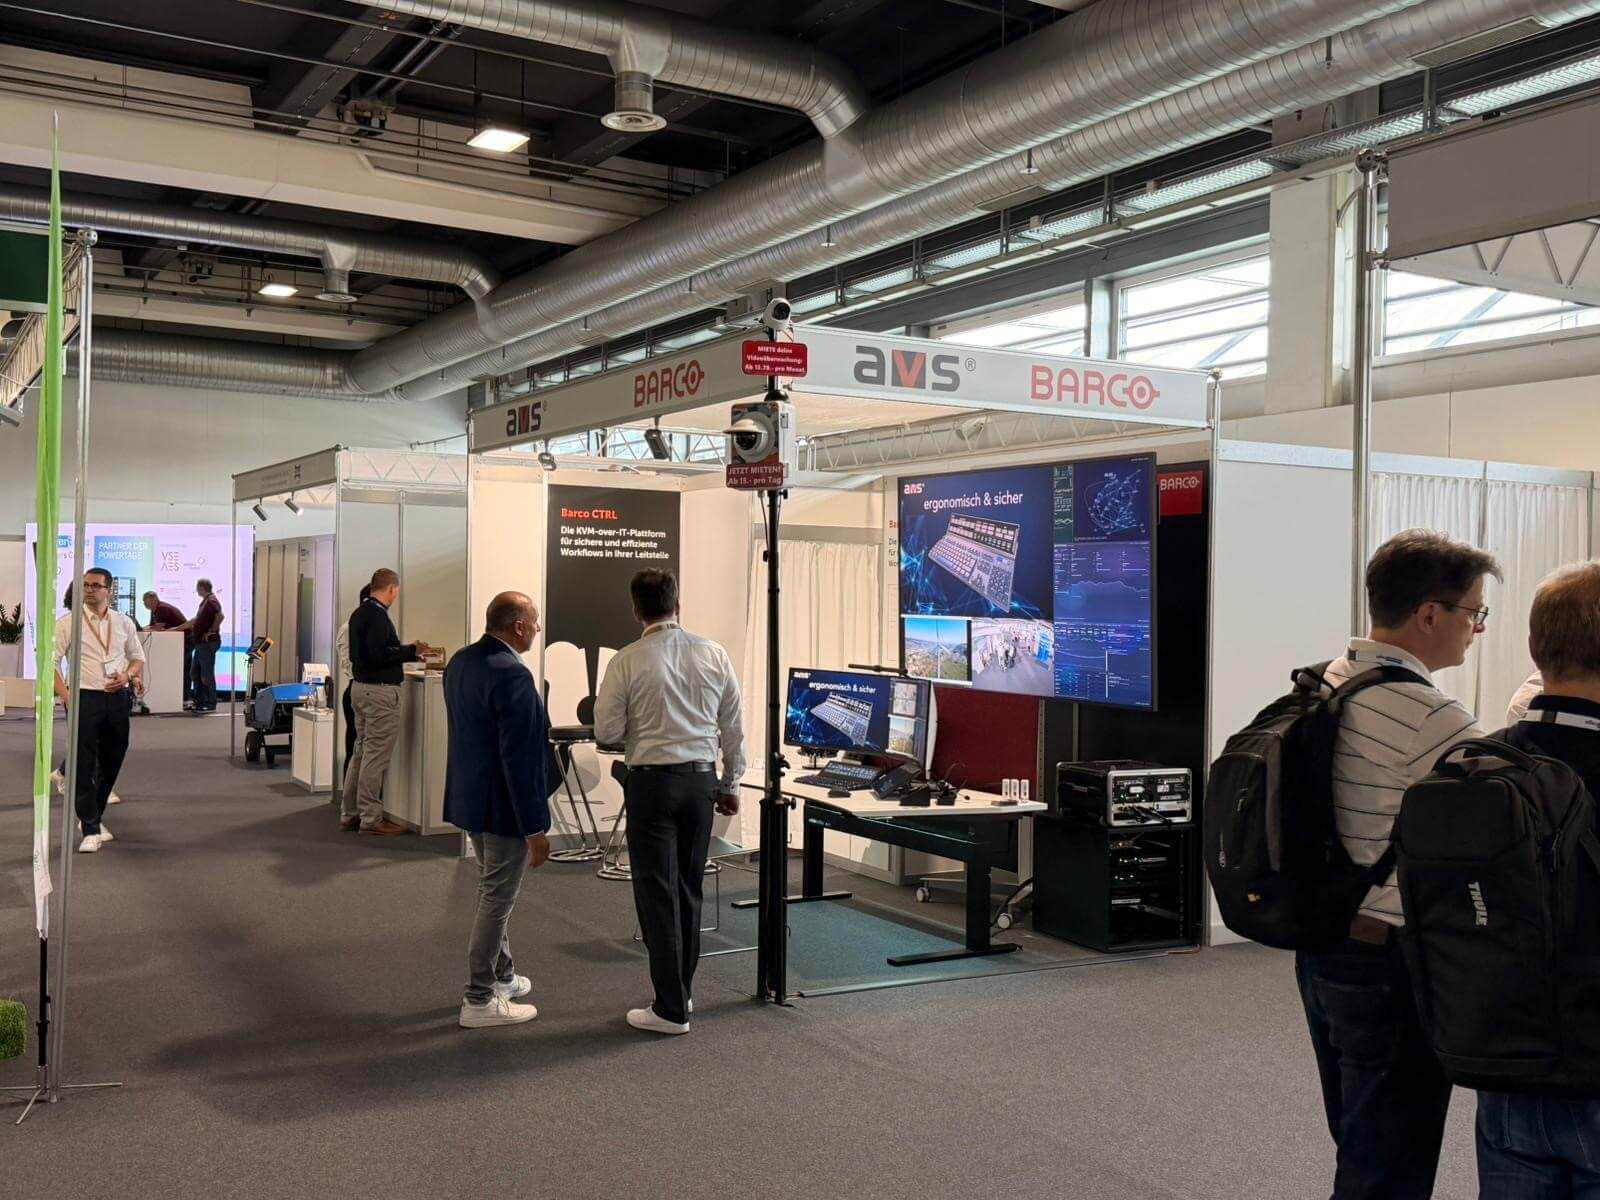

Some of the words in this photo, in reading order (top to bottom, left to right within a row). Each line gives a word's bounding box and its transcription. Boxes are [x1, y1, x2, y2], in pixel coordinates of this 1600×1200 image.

[634, 360, 704, 409] BARCO
[1031, 365, 1160, 410] BARCO
[728, 466, 748, 475] JETZT
[728, 477, 739, 486] Ab
[753, 479, 766, 487] pro
[768, 476, 782, 486] Tag
[1160, 476, 1200, 491] BARCO
[923, 494, 981, 513] ergonomisch
[983, 492, 991, 506] &
[993, 491, 1023, 505] sicher
[561, 508, 590, 518] Barco
[592, 509, 618, 520] CTRL
[560, 526, 575, 535] Die
[576, 527, 666, 538] KVM-over-IT-Plattform
[560, 537, 572, 546] für
[574, 538, 603, 547] sichere
[604, 539, 620, 548] und
[622, 540, 658, 549] effiziente
[161, 551, 180, 561] VSE
[560, 548, 604, 558] Workflows
[605, 549, 613, 558] in
[614, 549, 634, 558] Ihrer
[635, 550, 670, 559] Leitstelle
[809, 681, 852, 692] ergonomisch
[859, 684, 876, 694] sicher
